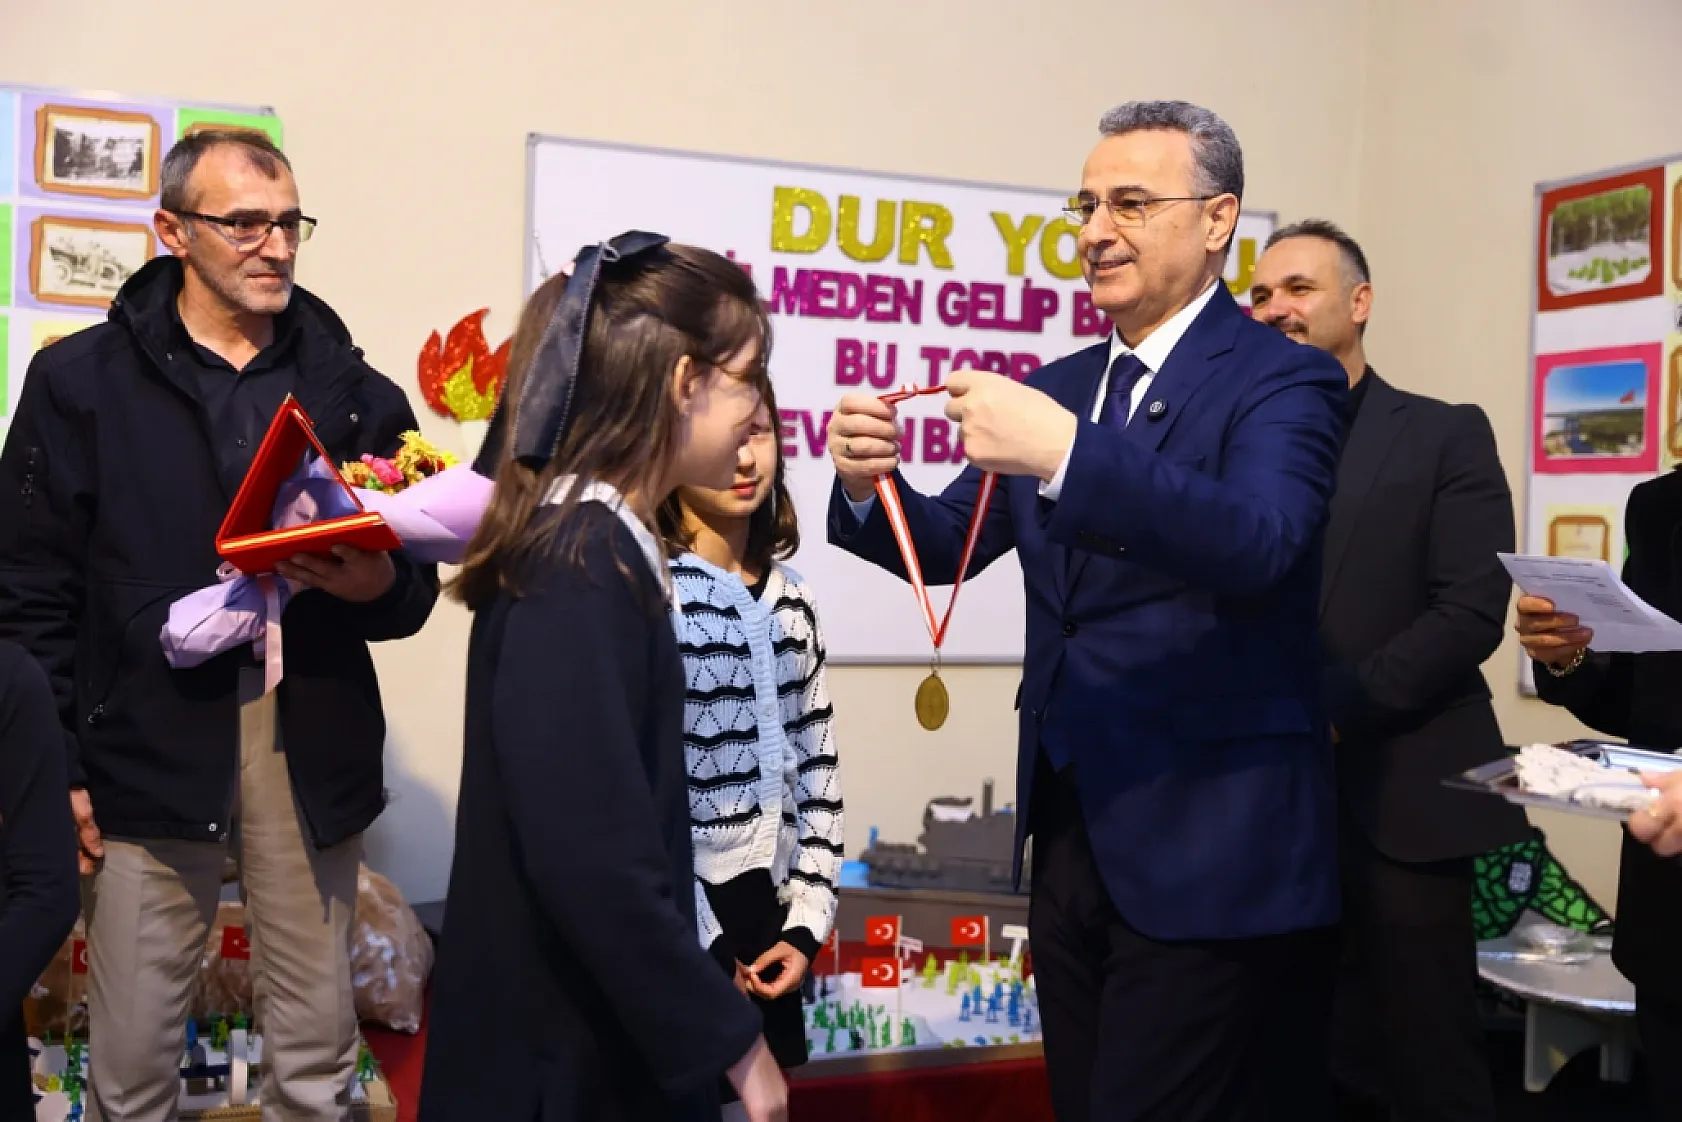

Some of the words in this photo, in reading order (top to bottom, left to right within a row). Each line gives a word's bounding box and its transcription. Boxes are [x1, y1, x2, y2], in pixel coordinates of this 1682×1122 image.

[771, 186, 954, 270] DUR
[937, 278, 1059, 333] GELİP
[835, 338, 898, 389] BU
